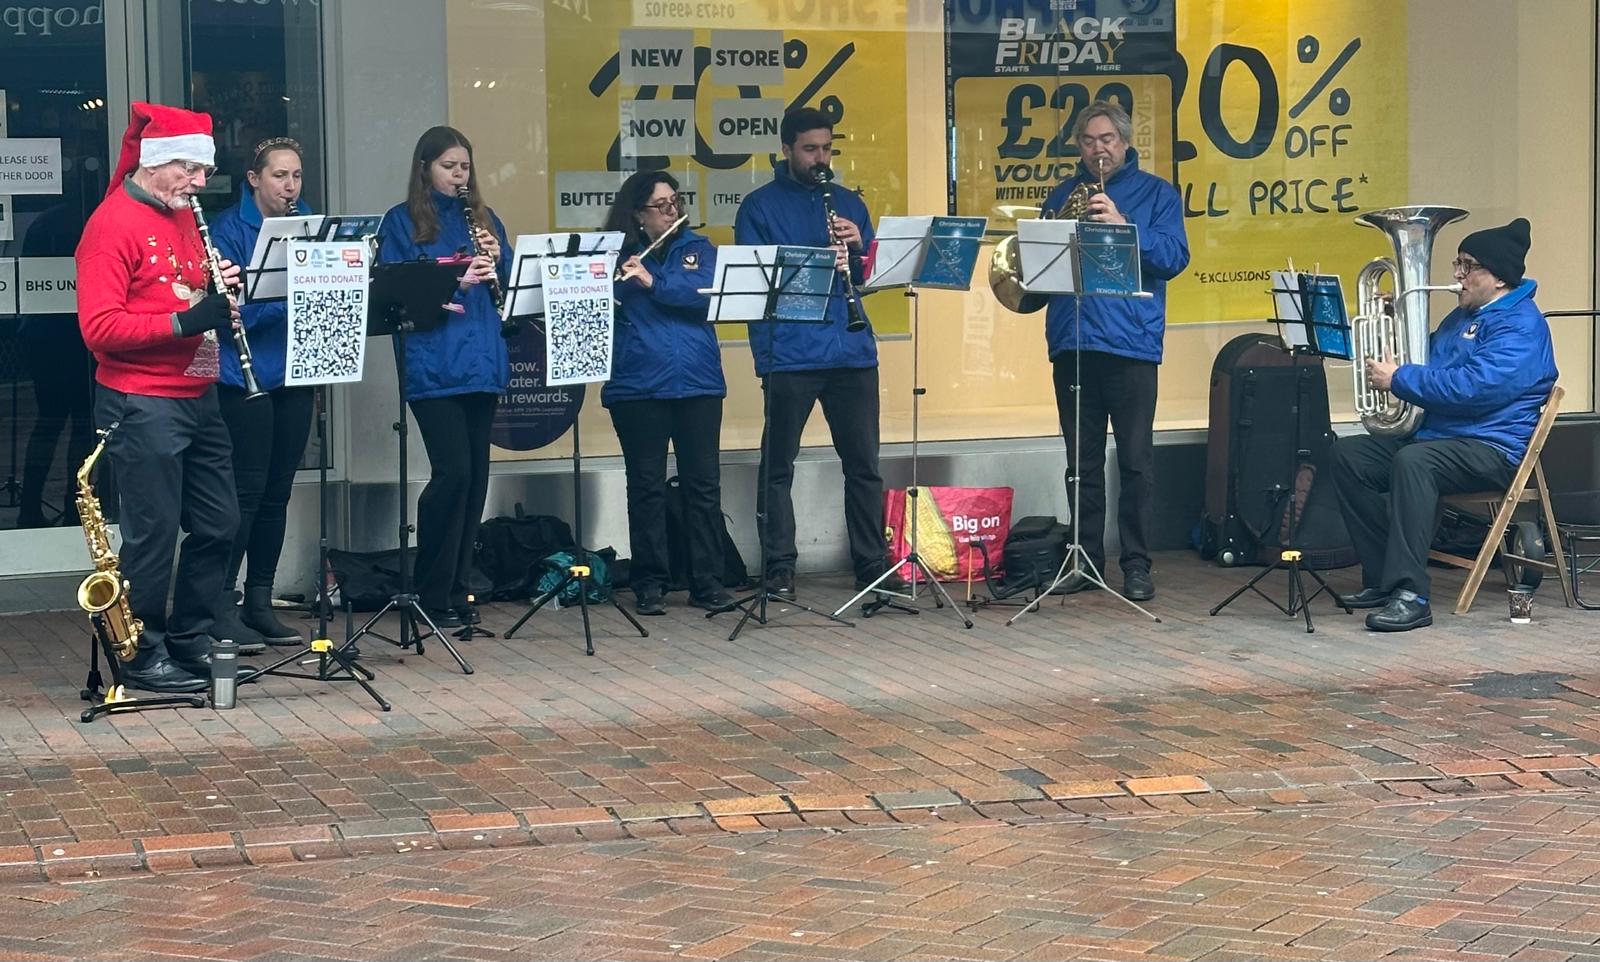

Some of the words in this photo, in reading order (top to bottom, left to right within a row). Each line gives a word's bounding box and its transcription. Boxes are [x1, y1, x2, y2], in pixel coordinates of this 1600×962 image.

[1000, 17, 1127, 41] BLACK
[631, 49, 683, 67] NEW
[715, 49, 780, 67] STORE
[995, 41, 1125, 65] FRIDAY
[629, 118, 686, 138] NOW
[718, 117, 778, 136] OPEN
[1284, 124, 1353, 159] OFF
[0, 156, 27, 165] LEASE
[30, 155, 49, 165] USE
[0, 171, 22, 181] THER
[25, 171, 54, 181] DOOR
[994, 163, 1081, 183] VOUC
[713, 193, 741, 206] (THE
[995, 186, 1024, 200] WITH
[1178, 182, 1230, 217] LL
[25, 280, 53, 292] BHS
[57, 280, 76, 291] UN
[294, 276, 316, 285] SCAN
[319, 275, 330, 284] TO
[333, 275, 364, 284] DONATE
[548, 286, 568, 295] SCAN
[570, 286, 580, 294] TO
[581, 284, 609, 293] DONATE
[506, 376, 541, 388] ater.
[511, 389, 573, 404] rewards.
[952, 514, 978, 533] Big
[981, 516, 1000, 528] on
